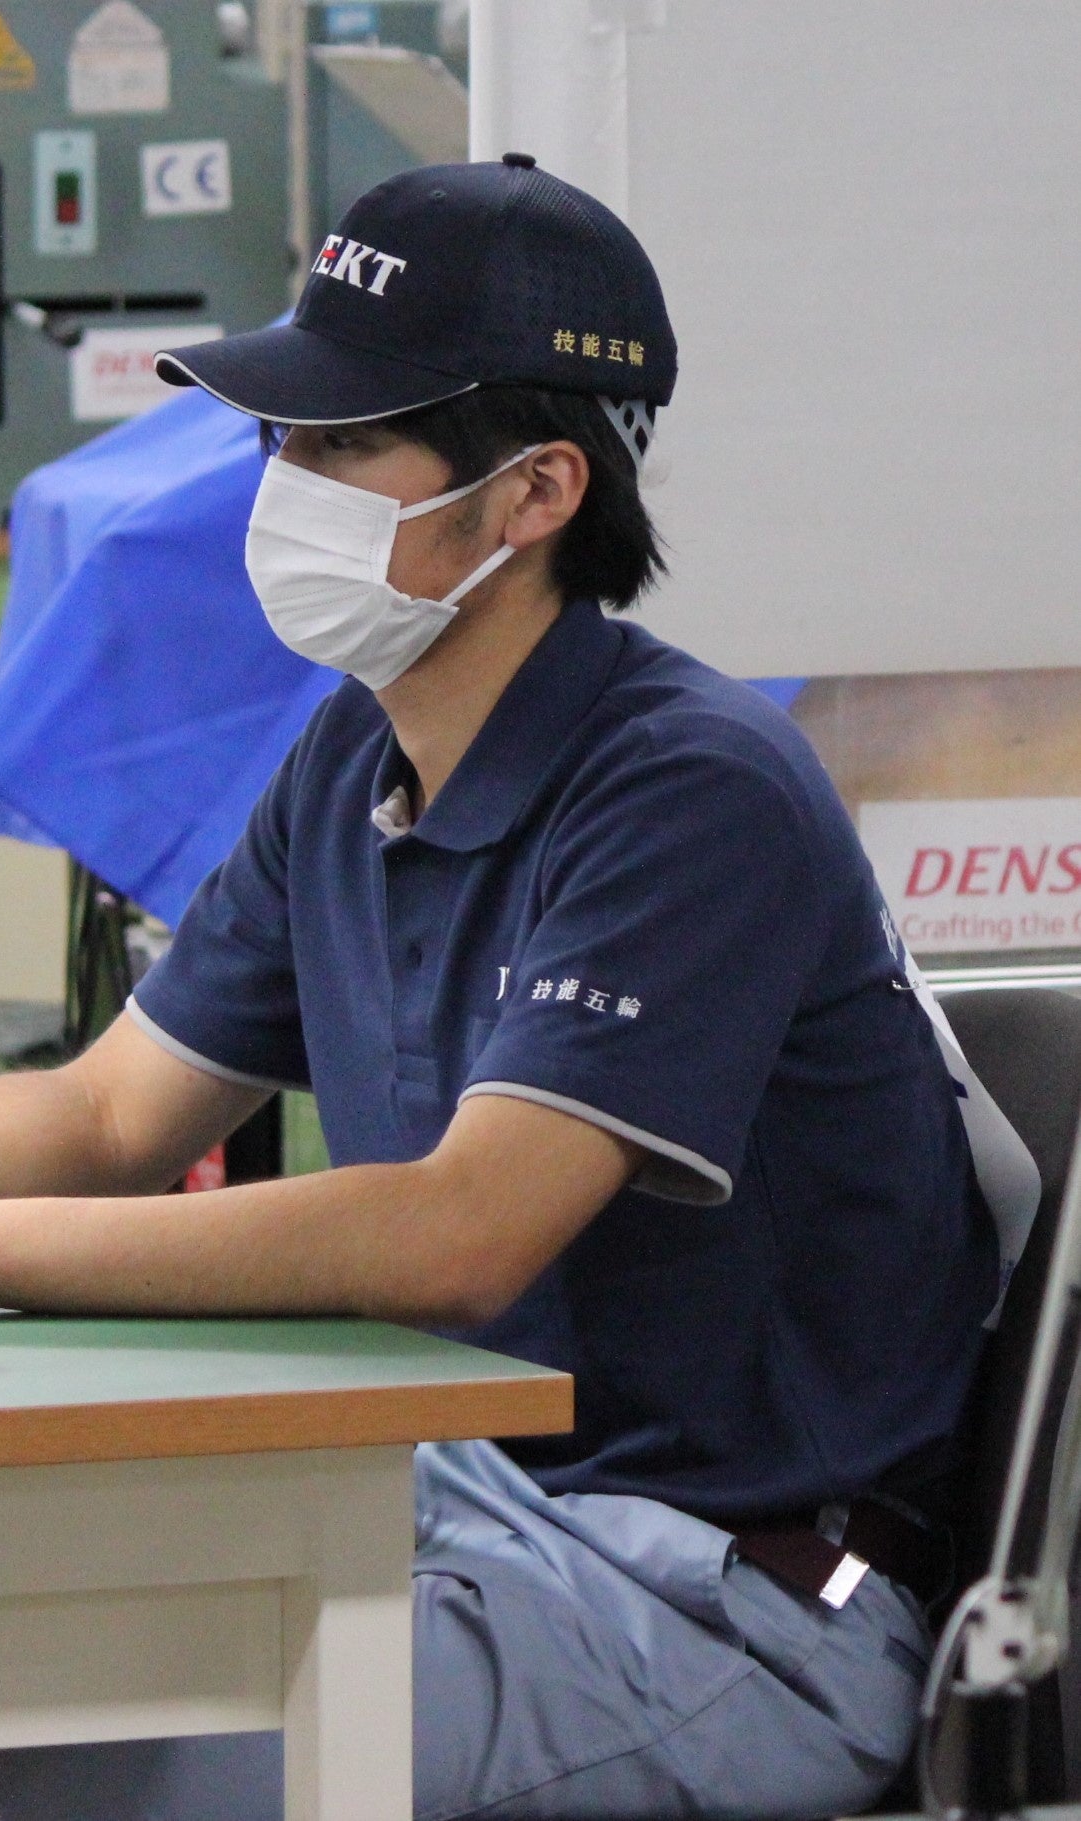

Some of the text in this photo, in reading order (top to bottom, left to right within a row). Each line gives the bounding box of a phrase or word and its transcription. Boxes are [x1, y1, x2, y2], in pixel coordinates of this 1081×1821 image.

[311, 234, 407, 296] EKT
[553, 329, 645, 367] 技能五輪
[901, 912, 1013, 945] Crafting
[1020, 911, 1066, 937] the
[531, 978, 642, 1019] 技能五輪
